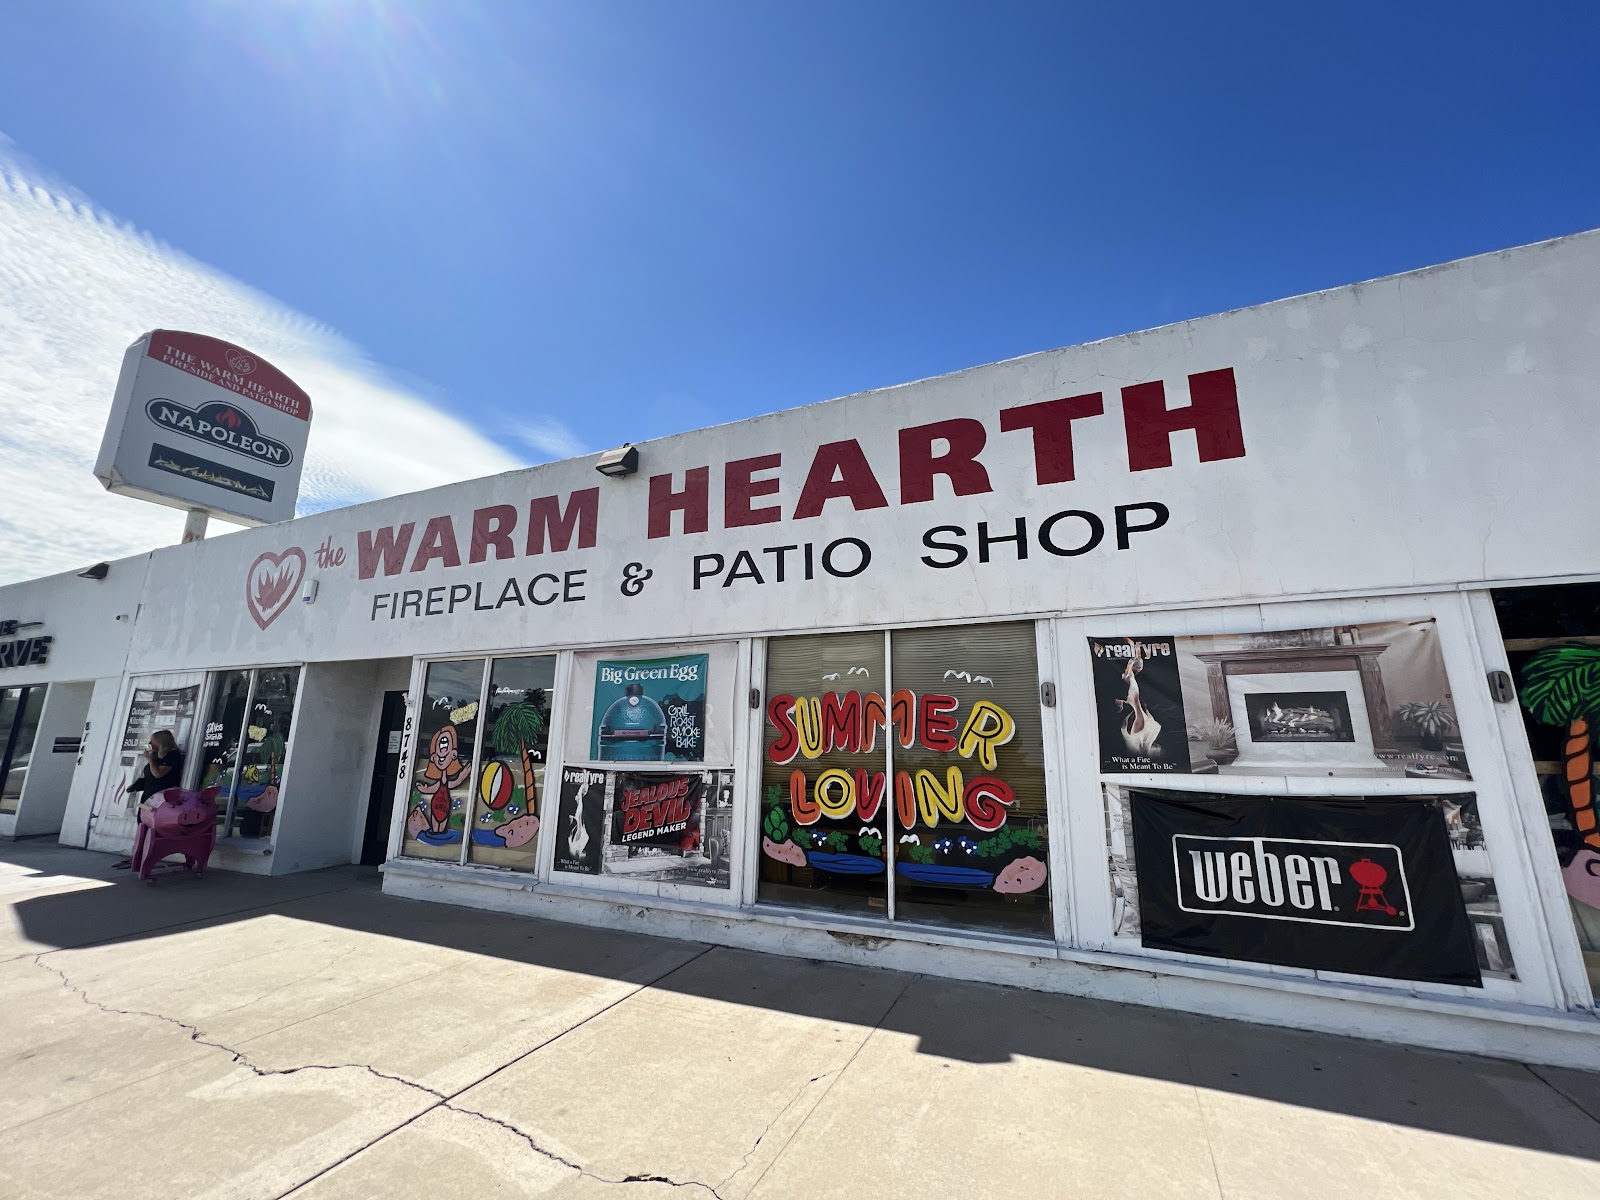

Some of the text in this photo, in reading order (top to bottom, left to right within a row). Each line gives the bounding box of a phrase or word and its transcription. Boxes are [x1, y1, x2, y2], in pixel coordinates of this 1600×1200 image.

[162, 354, 299, 416] FIRESIDE AND PATIO SHOP
[165, 345, 300, 409] THE WARM HEARTH
[158, 406, 283, 461] NAPOLEON
[314, 367, 1246, 580] the WARM HEARTH
[370, 501, 1170, 622] FIREPLACE & PATIO SHOP
[1105, 642, 1171, 660] realfyre
[601, 663, 699, 685] Big Green Egg
[668, 704, 690, 717] GRILL
[670, 715, 696, 727] ROAST
[124, 738, 139, 747] SOLD
[671, 727, 701, 739] SMOKE
[675, 737, 697, 749] BAKE
[768, 689, 1016, 771] SUMMER
[399, 718, 412, 779] 8748
[570, 771, 605, 786] realfyre
[621, 777, 690, 812] JEALOUS
[623, 797, 692, 834] DEVIL
[790, 766, 1015, 832] LOVING
[621, 822, 687, 843] LEGEND MAKER
[1188, 837, 1343, 912] weber
